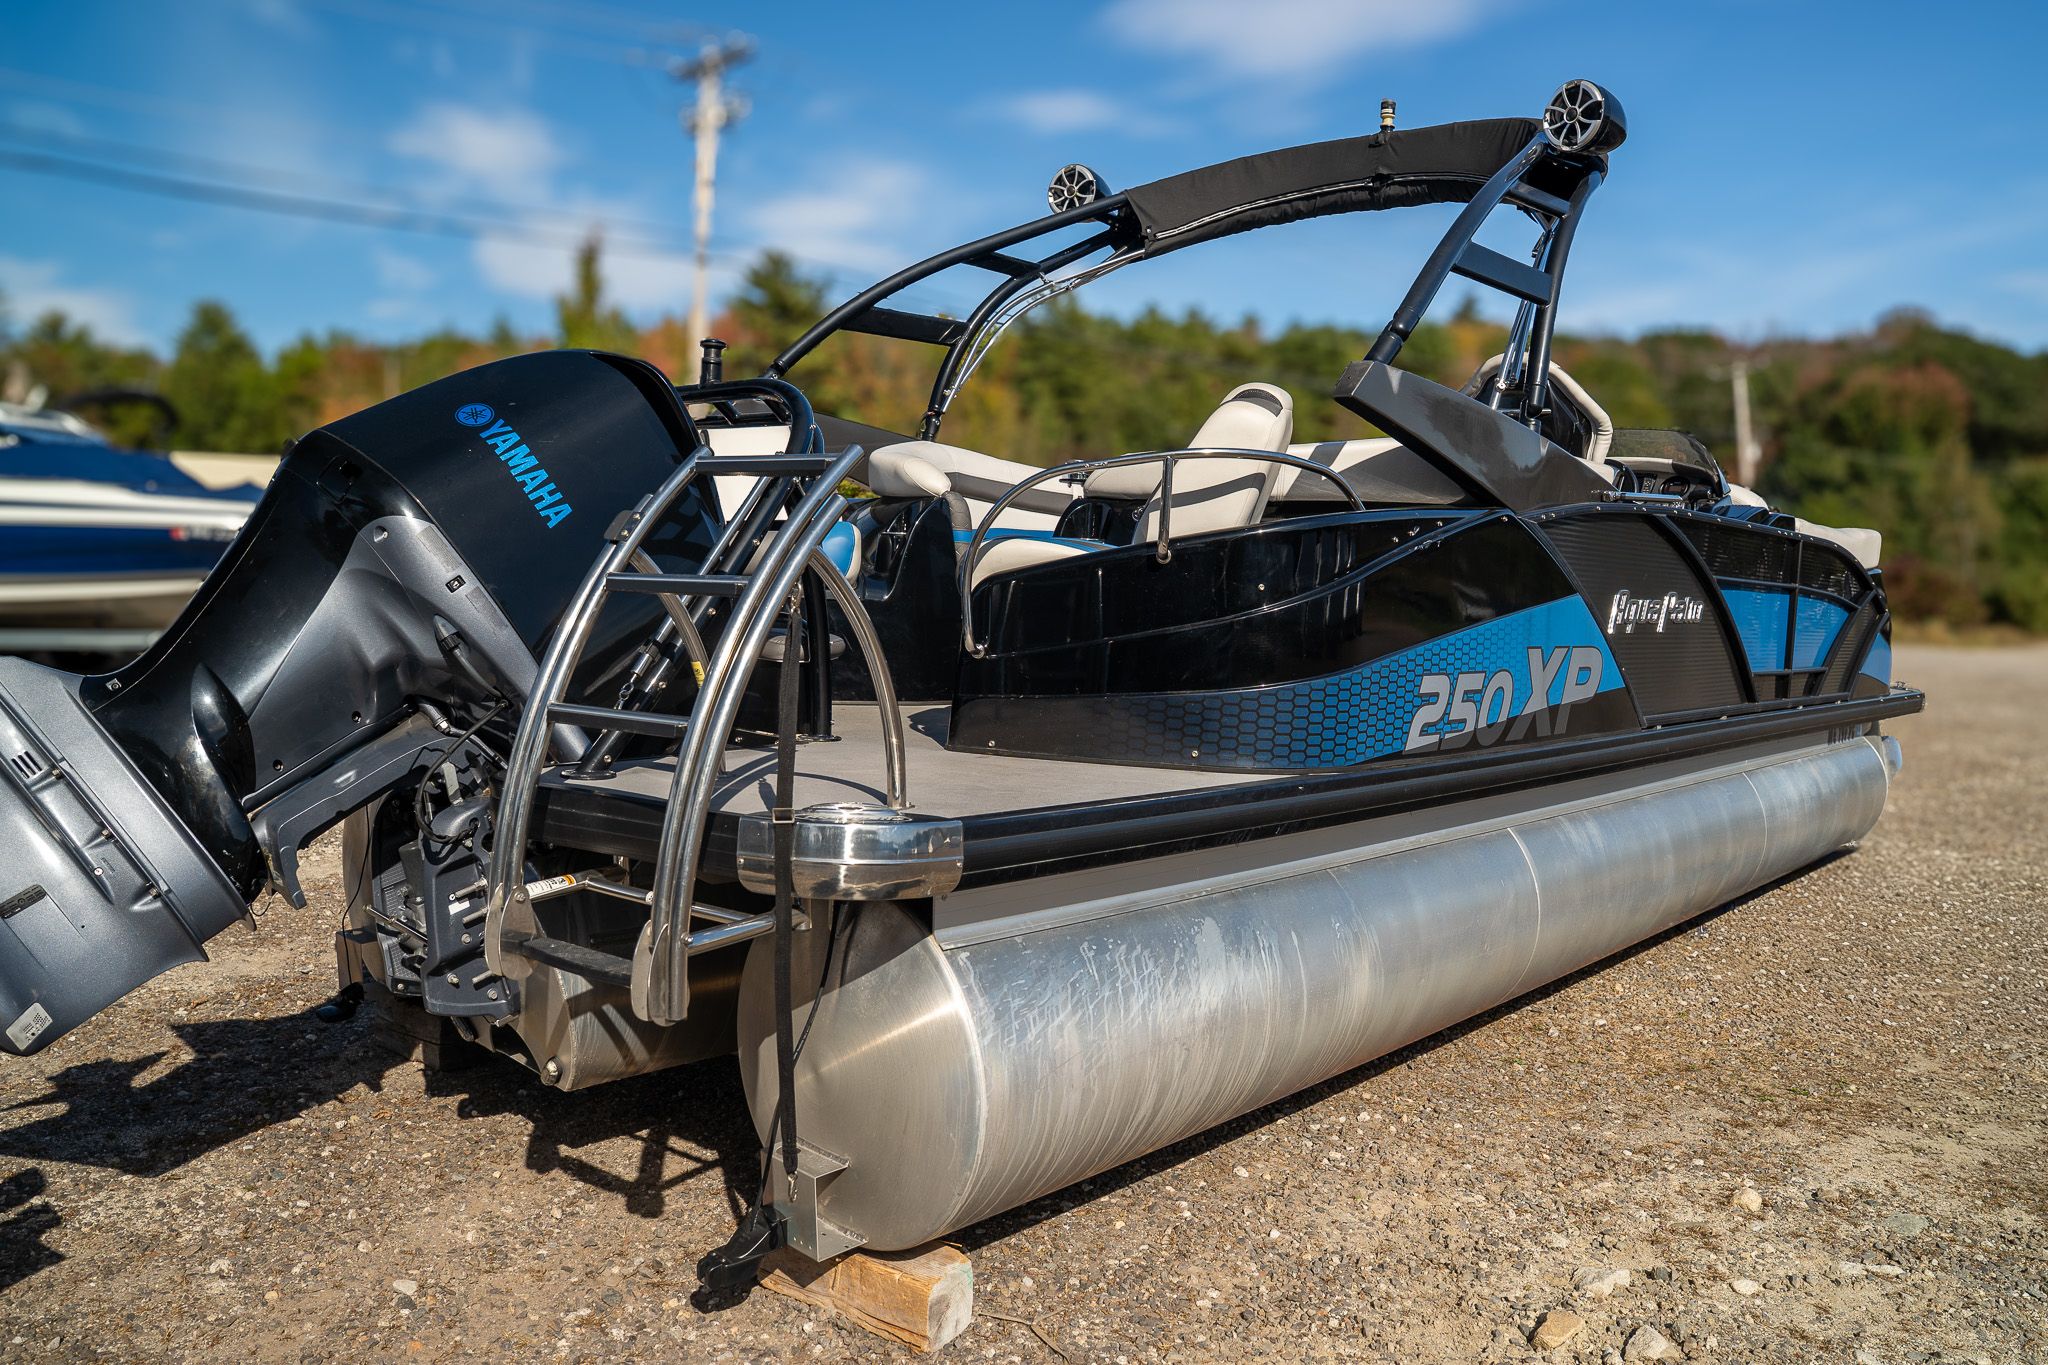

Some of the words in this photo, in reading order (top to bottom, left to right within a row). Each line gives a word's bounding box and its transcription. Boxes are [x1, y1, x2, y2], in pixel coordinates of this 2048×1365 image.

[480, 418, 572, 529] YAMAHA
[1402, 669, 1514, 755] 250
[1505, 646, 1603, 742] XP
